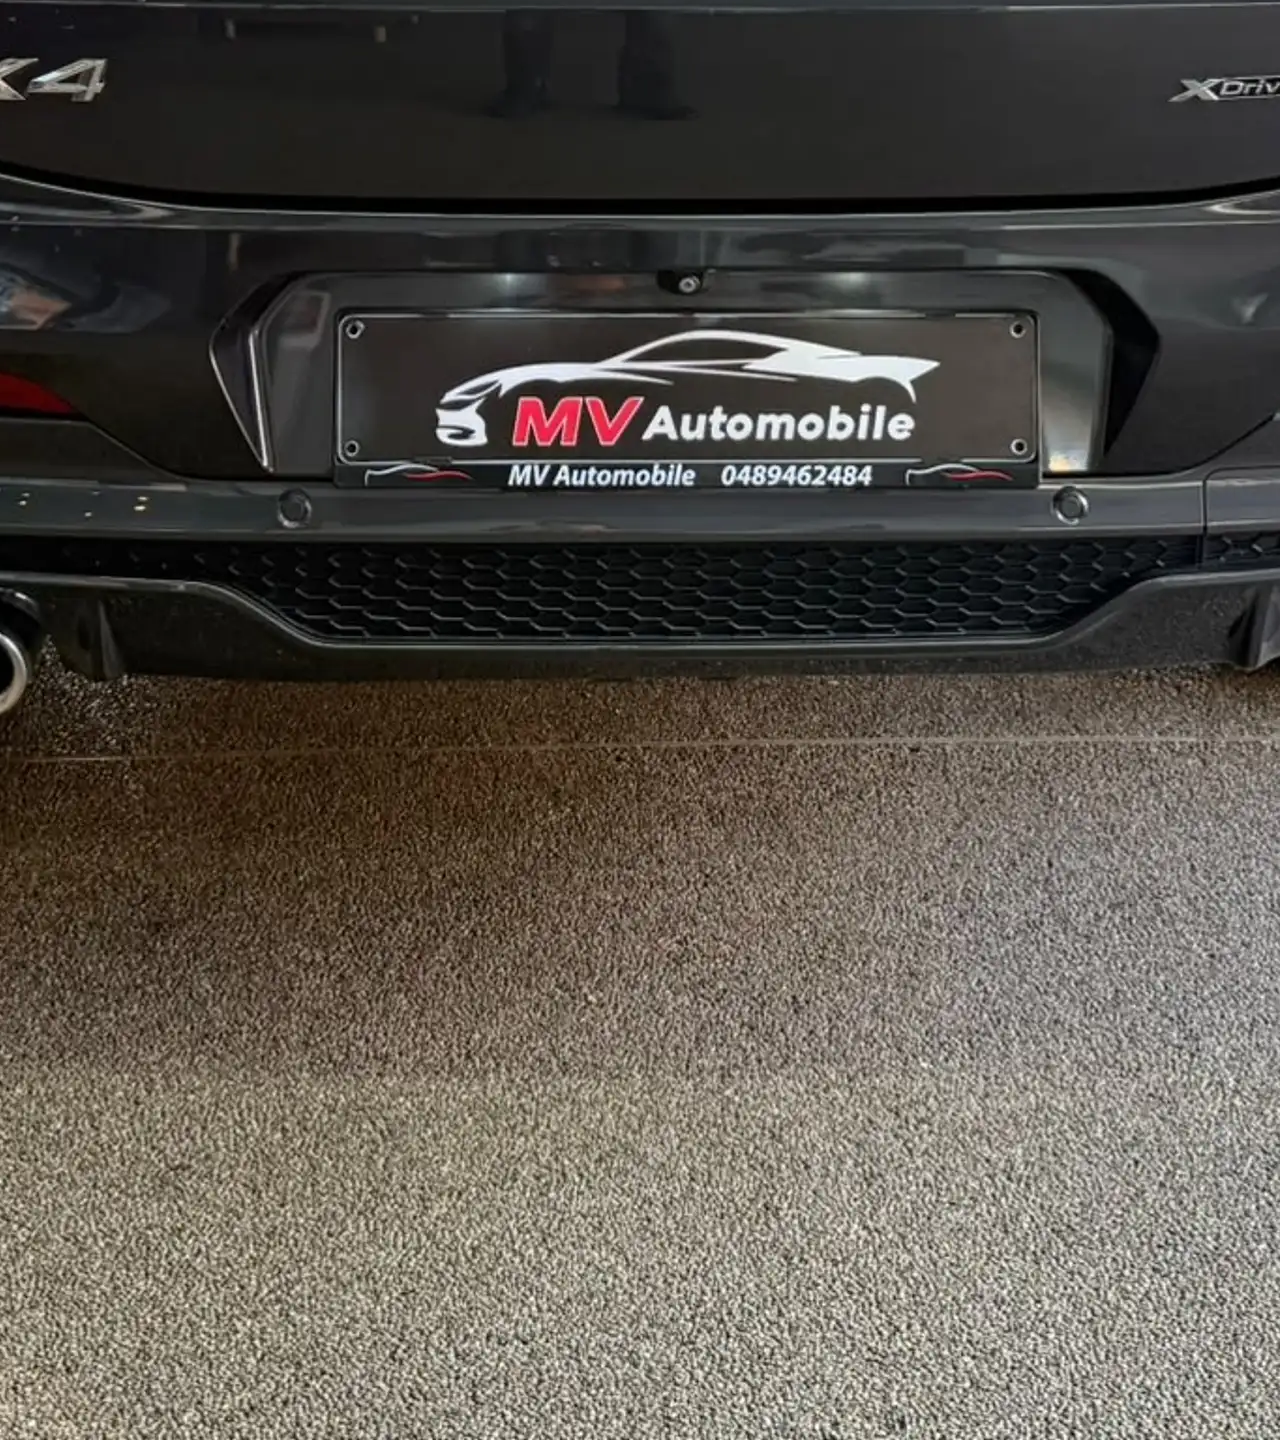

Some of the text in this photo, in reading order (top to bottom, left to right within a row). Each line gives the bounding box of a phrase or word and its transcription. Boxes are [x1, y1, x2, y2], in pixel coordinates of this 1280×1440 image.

[512, 396, 916, 447] MV Automobile
[508, 463, 873, 487] MV Automobile 0489462484
